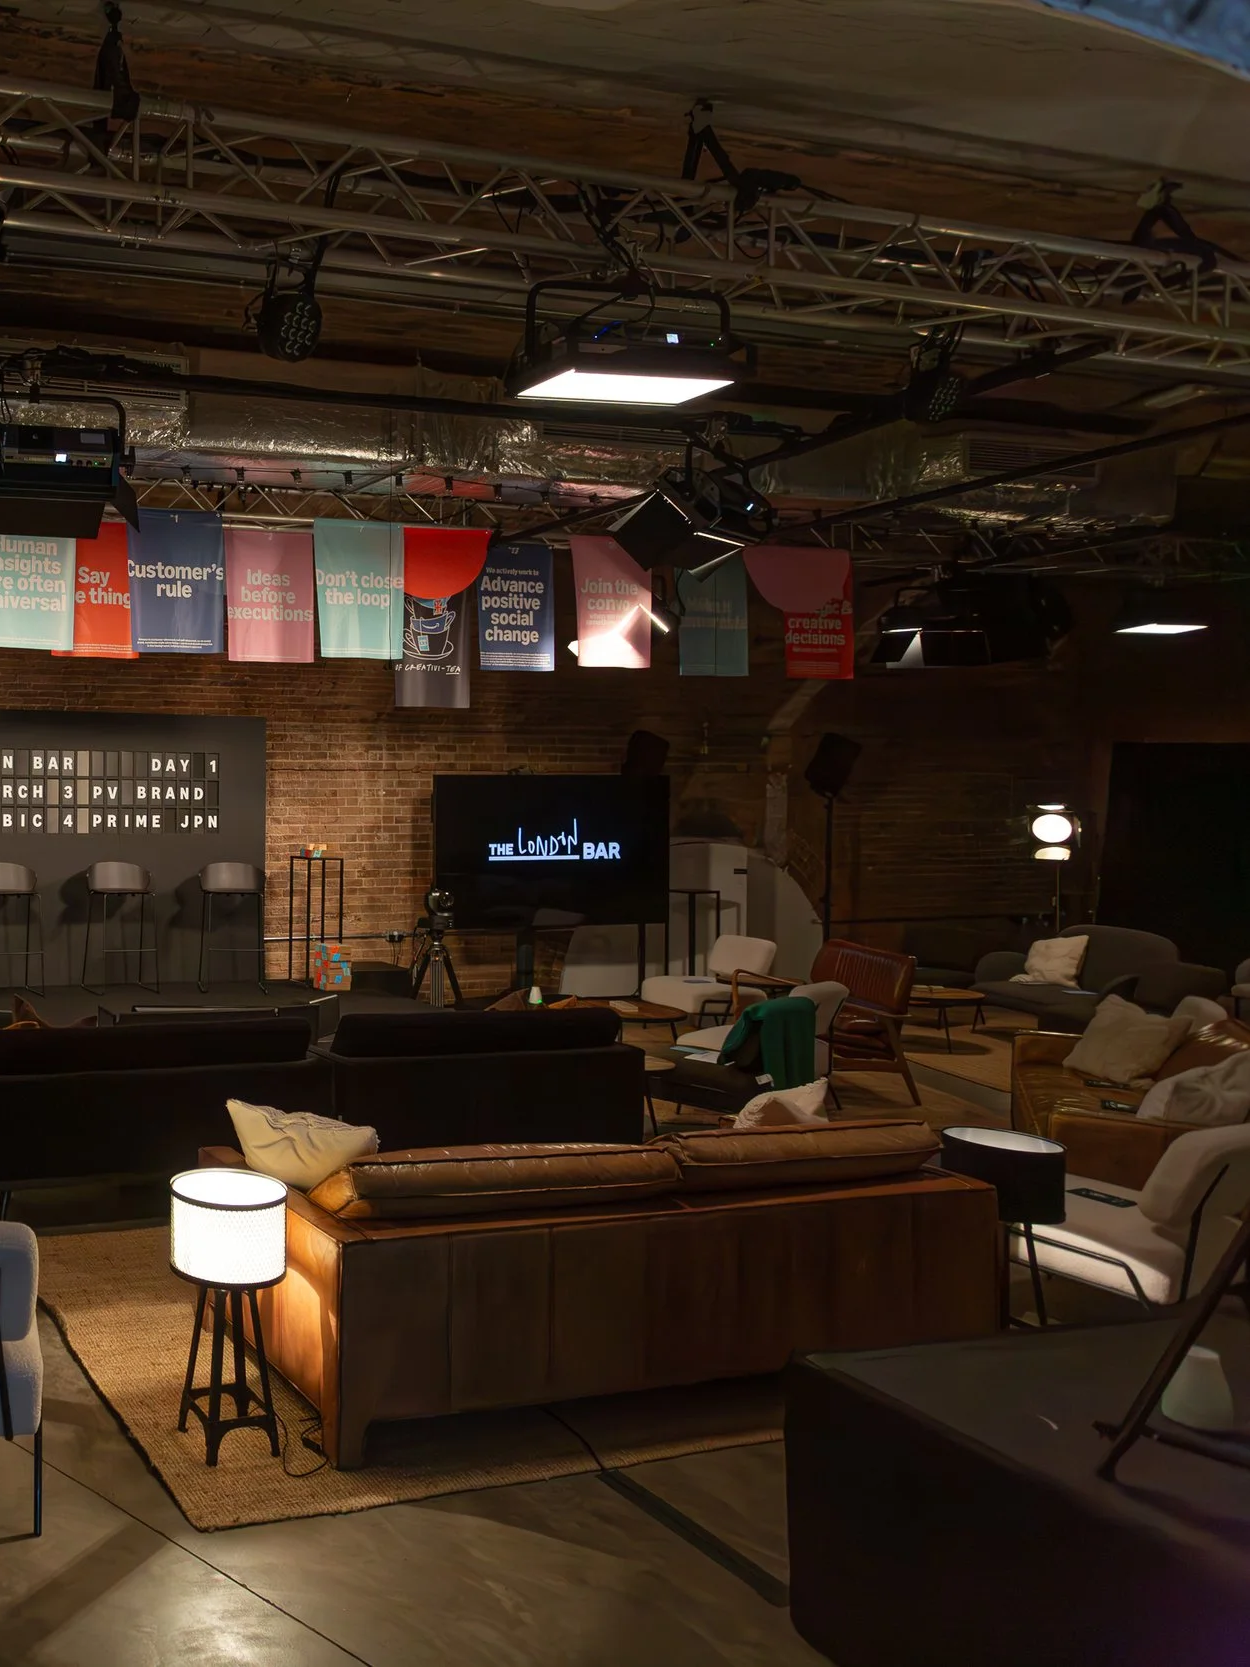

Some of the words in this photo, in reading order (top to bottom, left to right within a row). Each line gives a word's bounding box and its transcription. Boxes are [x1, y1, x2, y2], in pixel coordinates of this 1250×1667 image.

[78, 566, 110, 587] Say
[128, 560, 224, 580] Customer's
[247, 569, 290, 587] Ideas
[316, 569, 358, 587] Don't
[361, 571, 404, 589] close
[496, 568, 518, 576] actively
[17, 574, 67, 593] often
[156, 581, 193, 598] rule
[480, 576, 544, 594] Advance
[581, 578, 613, 594] Join
[614, 579, 639, 596] the
[89, 587, 130, 609] thing
[241, 586, 296, 604] before
[325, 588, 354, 605] the
[357, 590, 390, 609] loop
[481, 593, 541, 611] positive
[227, 605, 314, 622] executions
[490, 610, 534, 626] social
[787, 618, 842, 630] creative
[485, 626, 539, 645] change
[785, 629, 846, 645] decisions
[34, 756, 73, 770] BAR
[151, 758, 189, 772] DAY
[209, 760, 217, 773] 1
[63, 785, 73, 799] 3
[93, 785, 118, 800] PV
[137, 786, 204, 800] BRAND
[63, 814, 73, 828] 4
[93, 814, 161, 828] PRIME
[180, 815, 218, 828] JPN
[488, 843, 514, 855] THE
[518, 818, 578, 856] LONDON
[582, 842, 621, 860] BAR
